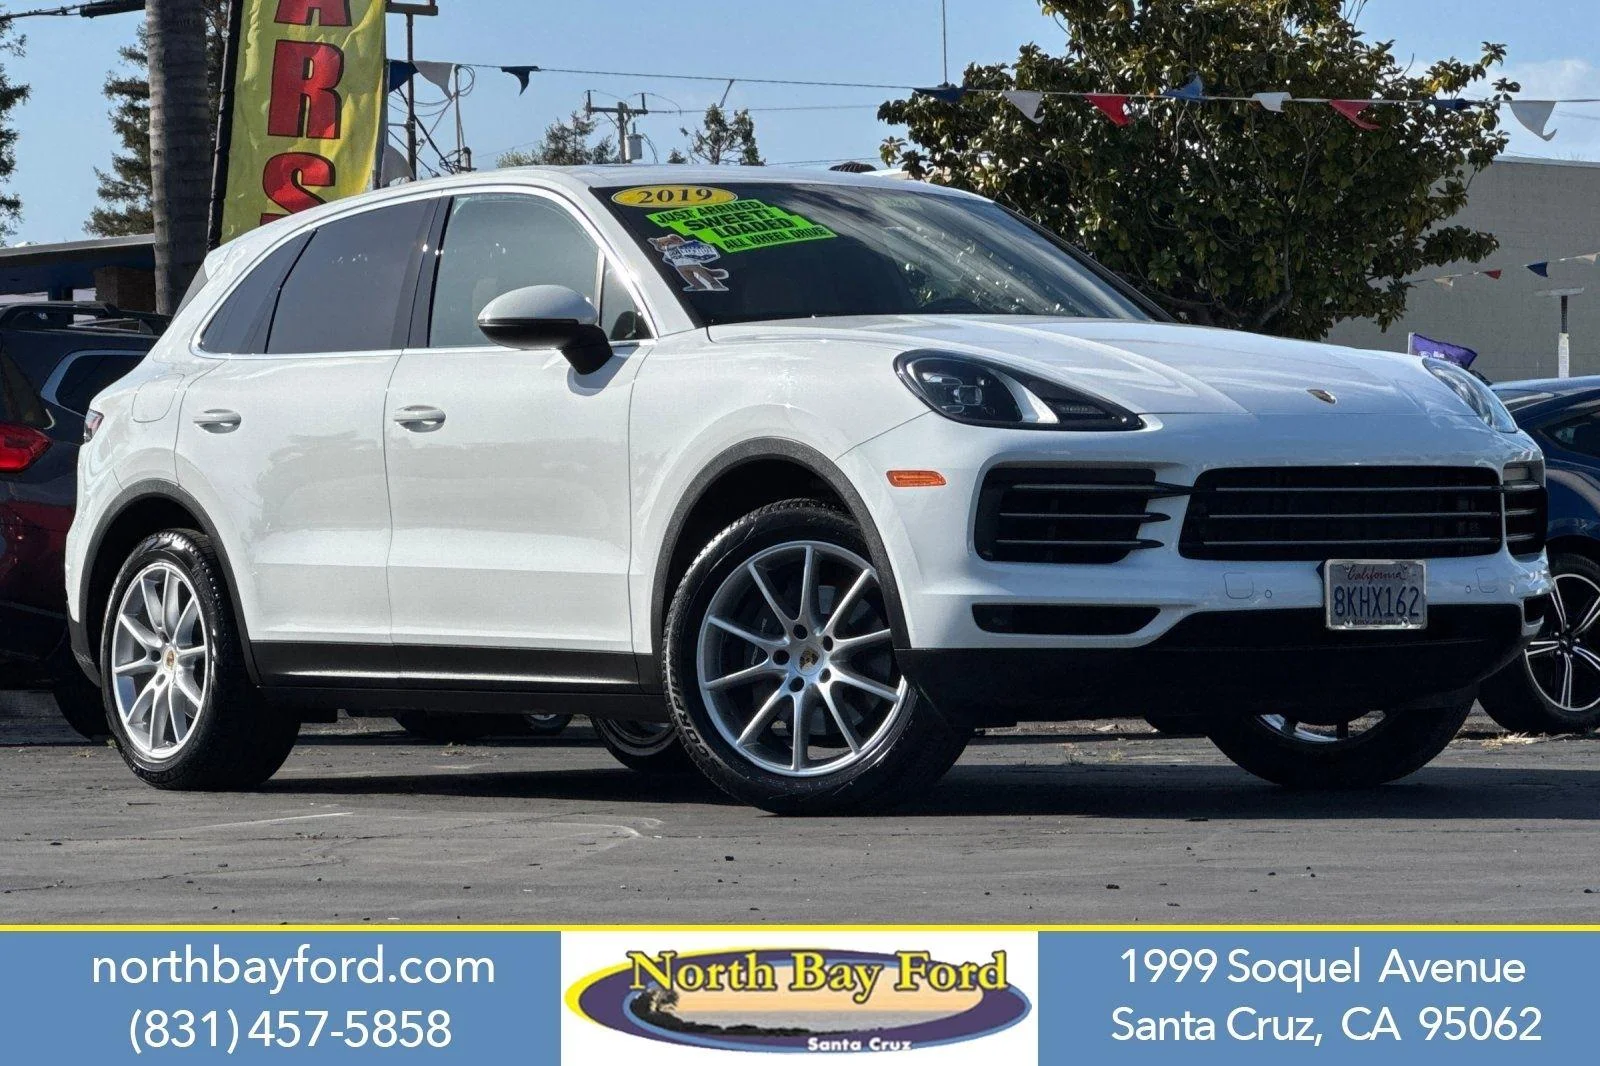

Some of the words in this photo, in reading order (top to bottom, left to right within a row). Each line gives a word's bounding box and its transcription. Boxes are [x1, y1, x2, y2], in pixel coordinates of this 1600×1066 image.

[637, 189, 713, 204] 2019
[656, 209, 697, 224] JUST
[684, 209, 775, 231] SWEET!
[714, 219, 794, 238] LOADED
[724, 237, 748, 250] ALL
[750, 230, 791, 245] WHEEL
[793, 226, 827, 239] DRIVE
[1347, 564, 1406, 583] California
[1334, 585, 1420, 617] 8KHX162
